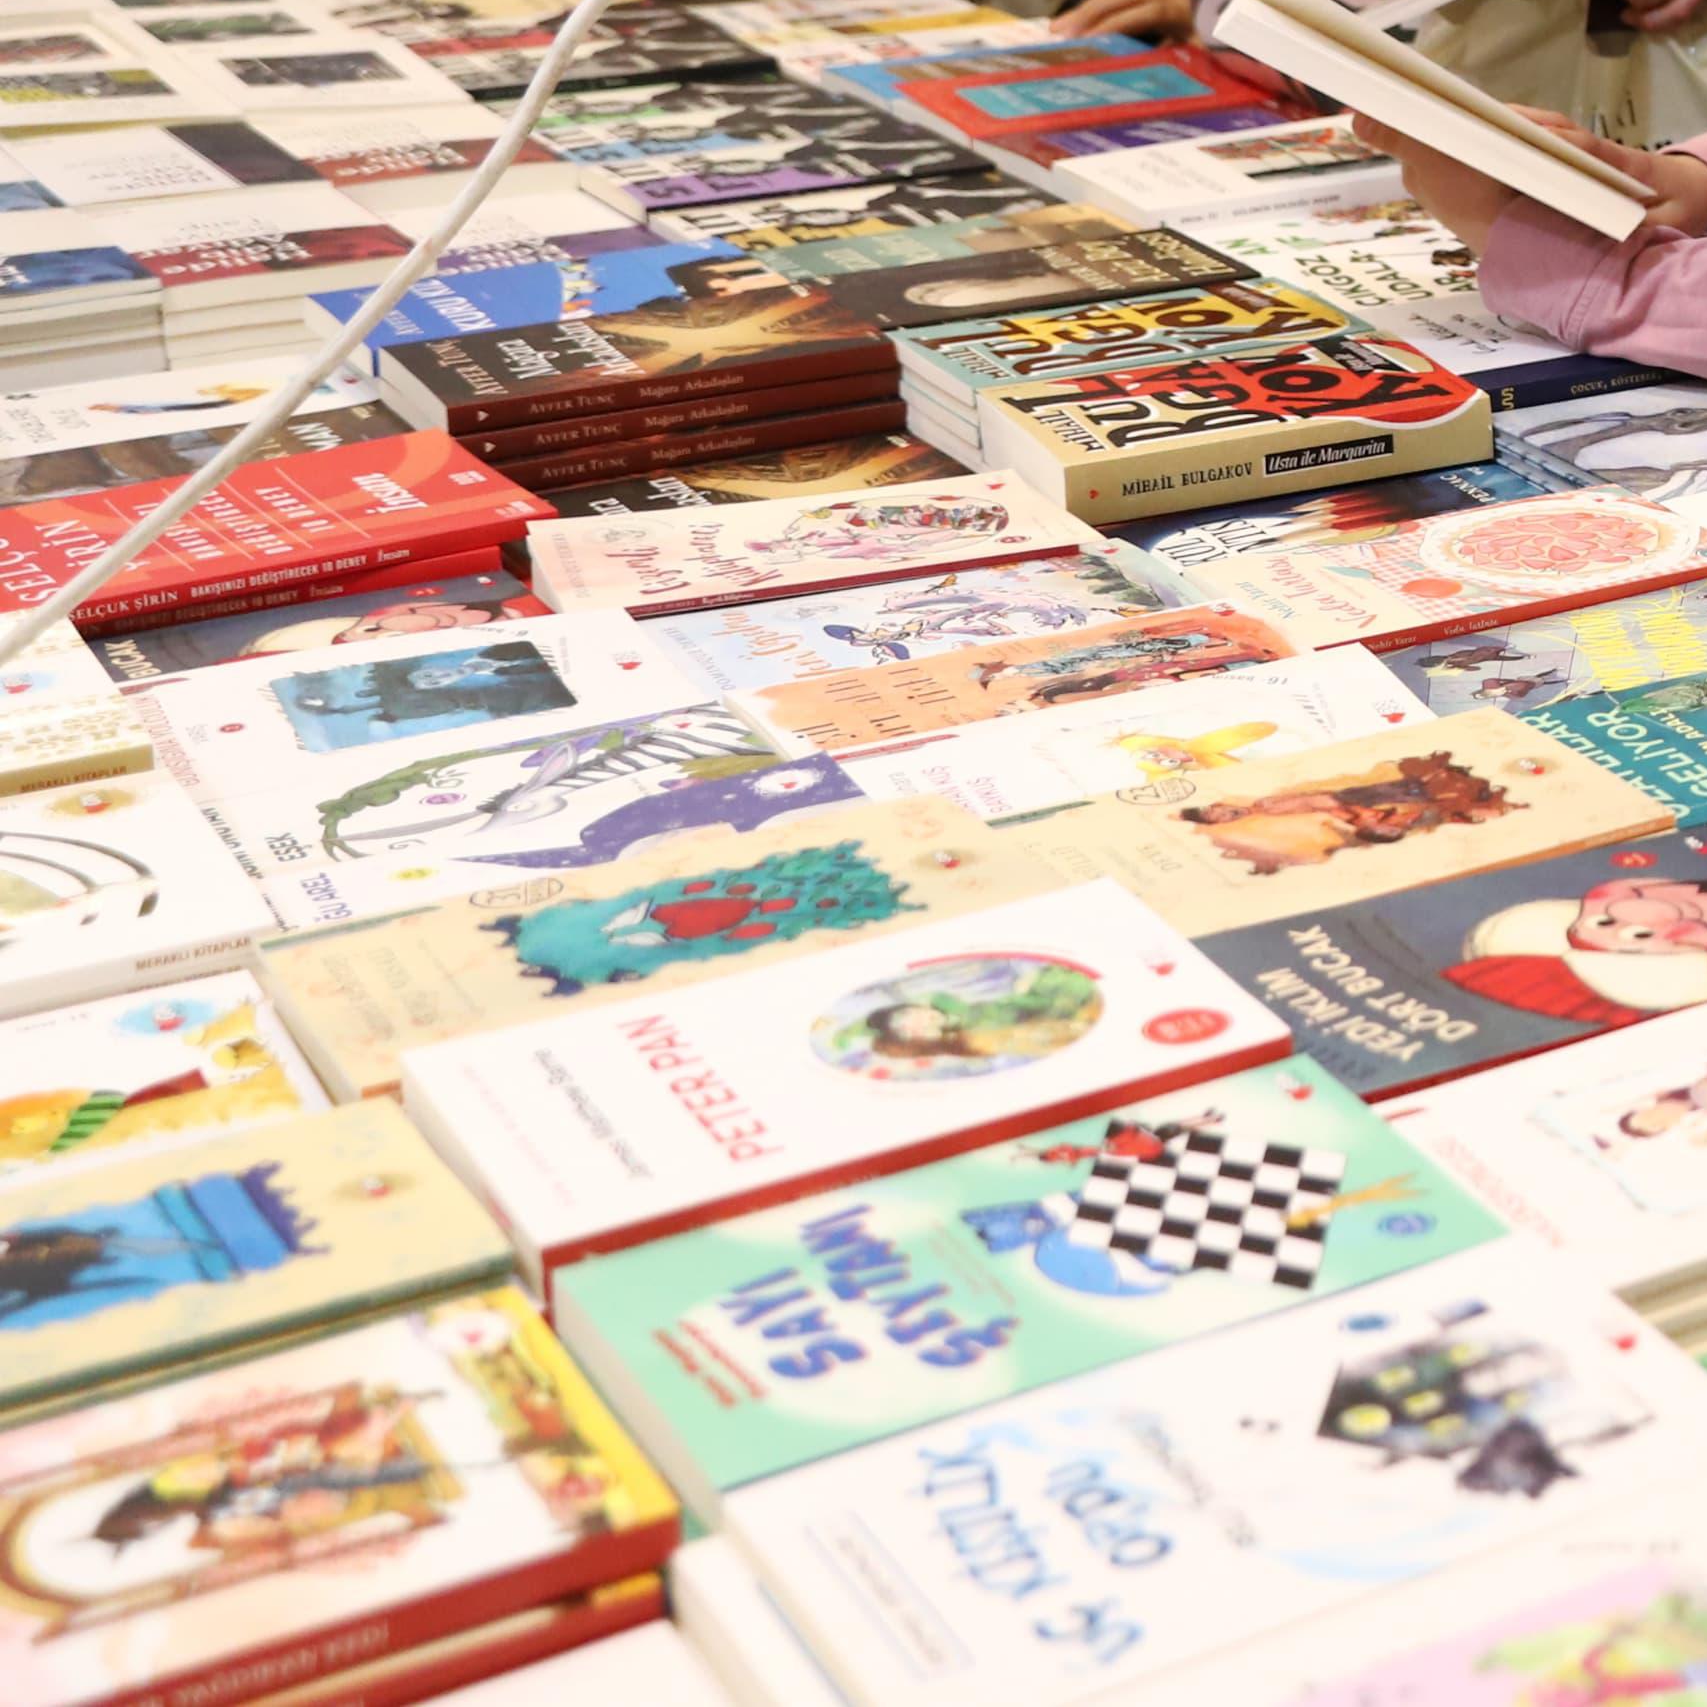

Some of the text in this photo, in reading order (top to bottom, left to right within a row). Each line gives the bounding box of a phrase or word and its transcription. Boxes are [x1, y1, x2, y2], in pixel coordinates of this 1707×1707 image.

[1294, 253, 1391, 308] ÇIKGÖZ
[1351, 248, 1435, 302] UDALA-
[496, 337, 562, 379] Mağara
[458, 362, 509, 397] AYFER
[529, 397, 574, 416] AYFER
[638, 382, 681, 400] Mağara
[534, 426, 580, 446] AYFER
[644, 410, 687, 429] Mağara
[541, 460, 587, 480] AYFER
[650, 443, 692, 462] Mağara
[1267, 439, 1387, 474] Usta ile Margarita
[1121, 461, 1254, 498] MİHAİL BULGAKOV
[69, 548, 411, 622] SELÇUK ŞİRİN BAKIŞINIZI DEĞİŞTİRECEK 10 DENEY İnsan
[104, 638, 162, 681] BUCAK
[20, 764, 128, 794] MERAKLI KİTAPLAR
[264, 831, 314, 864] EŞEK
[193, 936, 252, 959] KİTAPLAR
[1287, 924, 1479, 1044] DÖRT BUCAK
[1255, 966, 1427, 1063] YEDİ İKLİM
[616, 1012, 786, 1166] PETER PAN
